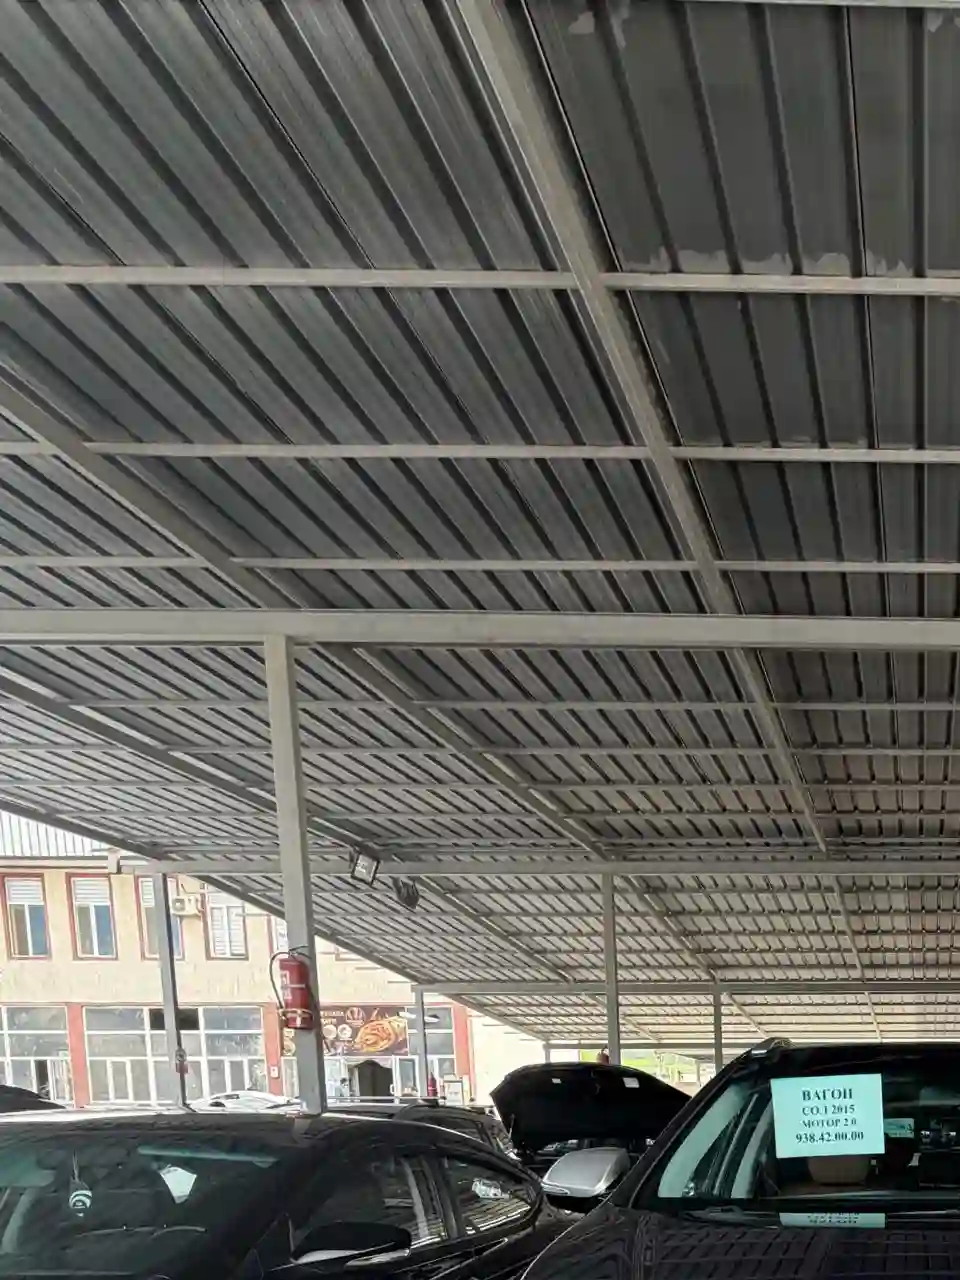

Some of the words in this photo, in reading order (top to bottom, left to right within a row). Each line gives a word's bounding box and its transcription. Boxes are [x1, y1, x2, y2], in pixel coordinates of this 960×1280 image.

[802, 1088, 853, 1101] ВАГОН
[832, 1104, 855, 1114] 2015
[802, 1119, 841, 1128] МОТОР
